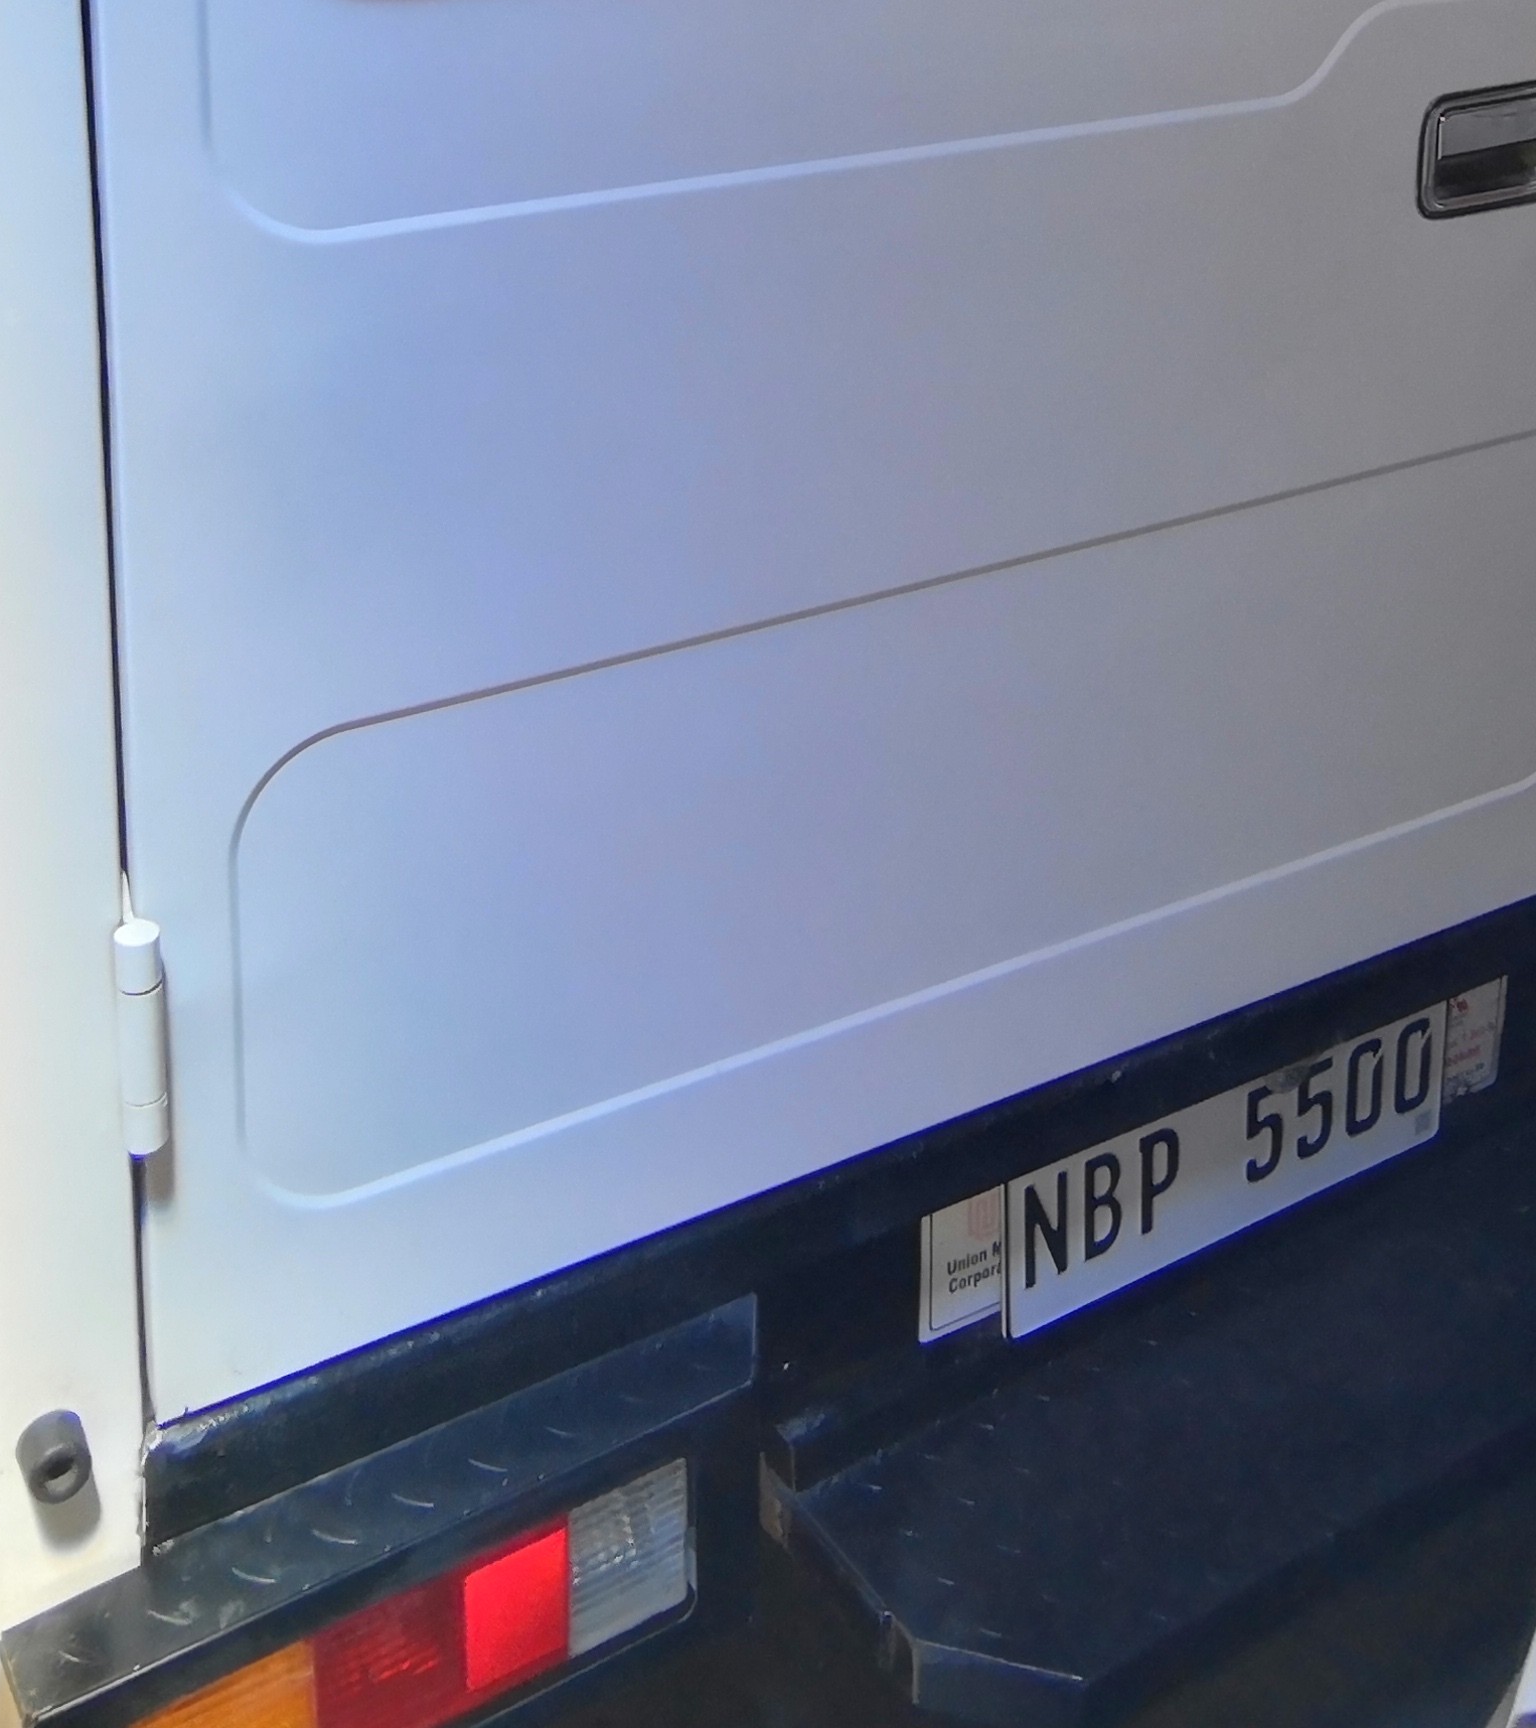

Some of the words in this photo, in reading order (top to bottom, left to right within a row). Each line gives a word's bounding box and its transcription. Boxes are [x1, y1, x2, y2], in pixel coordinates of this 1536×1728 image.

[1024, 1126, 1181, 1290] NBP
[1244, 1015, 1433, 1185] 5500
[946, 1249, 988, 1276] Union
